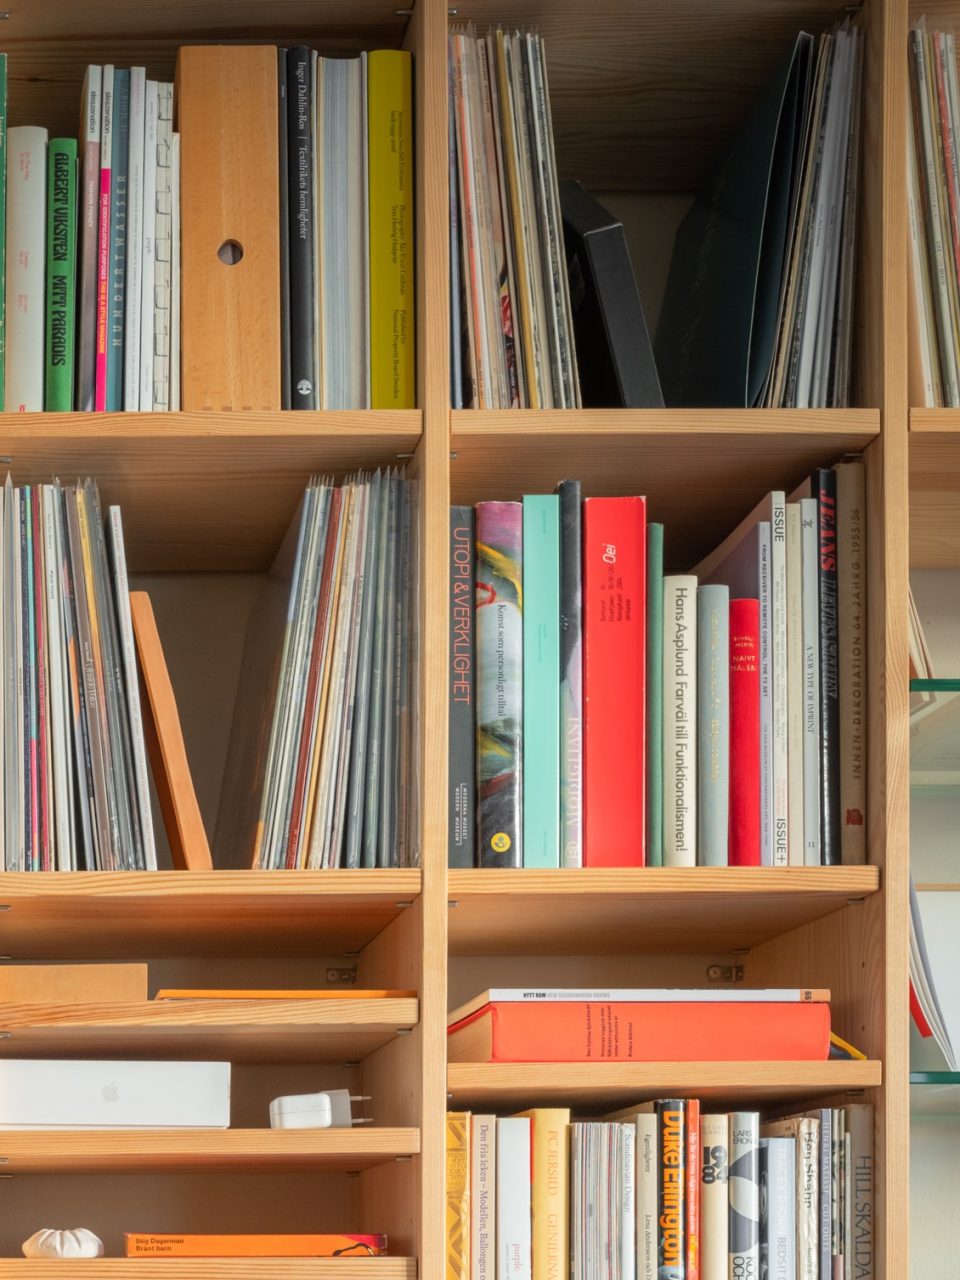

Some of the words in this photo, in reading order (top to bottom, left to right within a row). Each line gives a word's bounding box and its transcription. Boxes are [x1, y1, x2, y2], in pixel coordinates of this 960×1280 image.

[296, 62, 306, 83] Inger
[89, 91, 97, 133] sleazenation
[297, 85, 307, 130] Dahlin-Ros
[52, 152, 69, 205] ALBERT
[298, 146, 308, 189] Textilrikets
[53, 208, 68, 261] VIKSTEN
[298, 191, 309, 240] hemligheter
[113, 175, 126, 347] HUNDERTWASSER
[51, 275, 69, 306] MITT
[51, 310, 68, 365] PARADIS
[774, 507, 784, 542] ISSUE
[820, 488, 836, 572] JEANS
[850, 508, 860, 553] 1955/56
[454, 527, 470, 578] UTOPI
[601, 543, 617, 563] Oei
[454, 582, 470, 593] &
[675, 588, 688, 621] Hans
[762, 595, 767, 603] TO
[497, 604, 506, 629] Konst
[454, 594, 470, 705] VERKLIGHET
[672, 623, 689, 677] Asplund
[805, 652, 814, 670] NEW
[496, 650, 506, 693] personligt
[806, 672, 815, 690] TYPE
[497, 694, 506, 717] tilltal
[675, 682, 689, 722] Farväl
[807, 691, 815, 702] OF
[851, 637, 862, 779] INNEN-DEKORATION
[675, 726, 688, 739] till
[807, 704, 815, 733] IMPRINT
[566, 716, 580, 827] MODIGLIANI
[675, 743, 689, 852] Funktionalismen!
[479, 1125, 488, 1142] Den
[479, 1144, 488, 1158] fria
[663, 1111, 683, 1165] Duke
[804, 1132, 813, 1159] Ben
[822, 1122, 830, 1155] HENRI
[479, 1160, 488, 1182] leken
[548, 1148, 558, 1196] JERSILD
[623, 1134, 631, 1183] Scandinavian
[777, 1148, 787, 1191] TRACEY
[822, 1156, 830, 1193] MATISSE
[856, 1156, 871, 1199] HILL
[623, 1185, 631, 1212] Design
[804, 1164, 813, 1209] Shahn
[478, 1190, 488, 1231] Modellen,
[660, 1167, 683, 1267] Ellington
[777, 1194, 787, 1234] THORN
[822, 1203, 830, 1251] CUT-OUTS
[478, 1233, 488, 1273] Ballongen
[777, 1236, 787, 1273] BEDSIT
